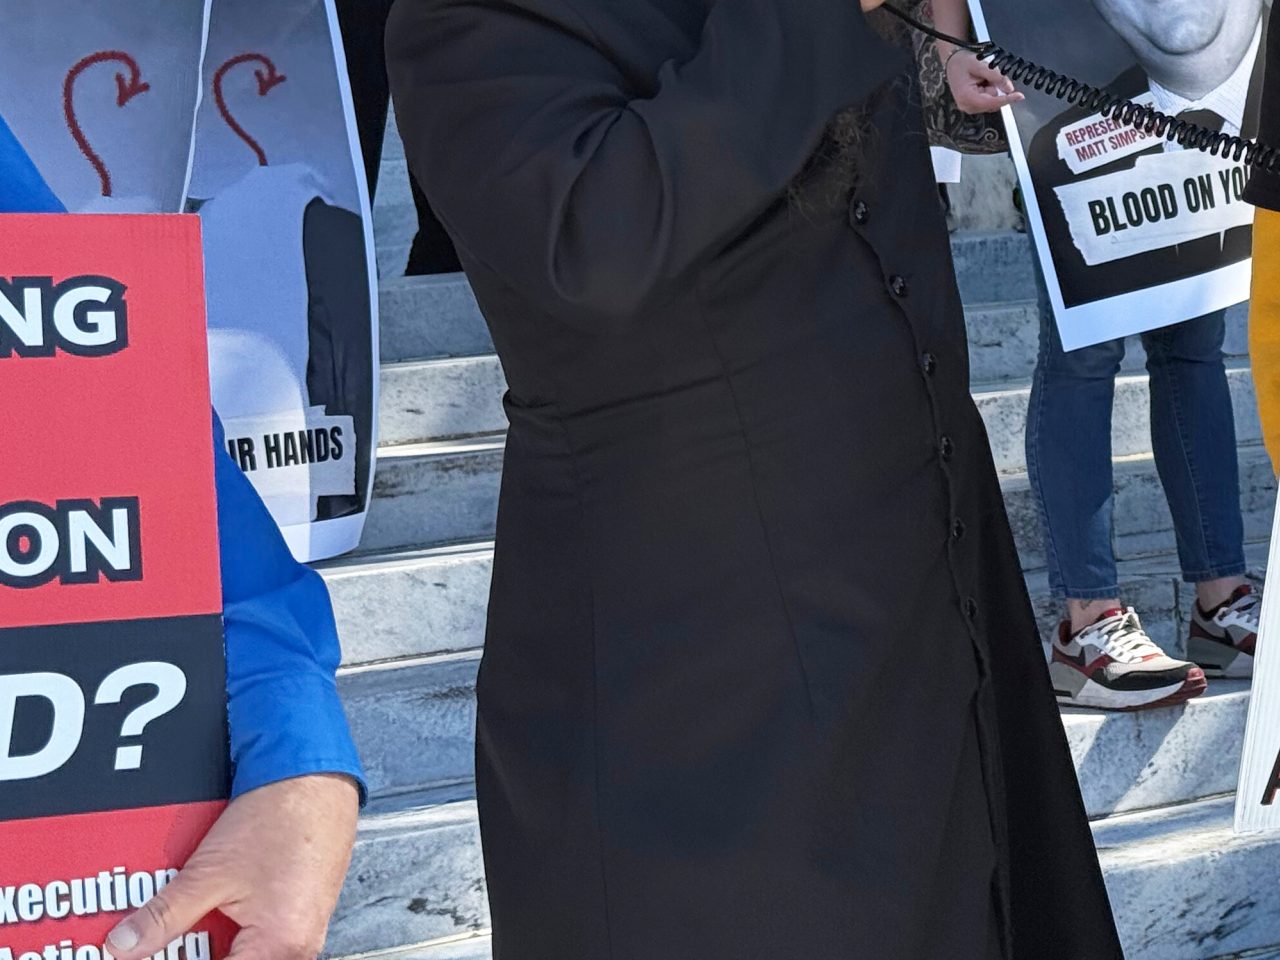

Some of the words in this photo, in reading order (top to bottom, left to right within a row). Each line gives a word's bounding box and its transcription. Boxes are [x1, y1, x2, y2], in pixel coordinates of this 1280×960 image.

[1075, 139, 1108, 162] MATT
[1088, 183, 1179, 237] BLOOD
[1183, 173, 1216, 211] ON
[263, 426, 343, 469] HANDS
